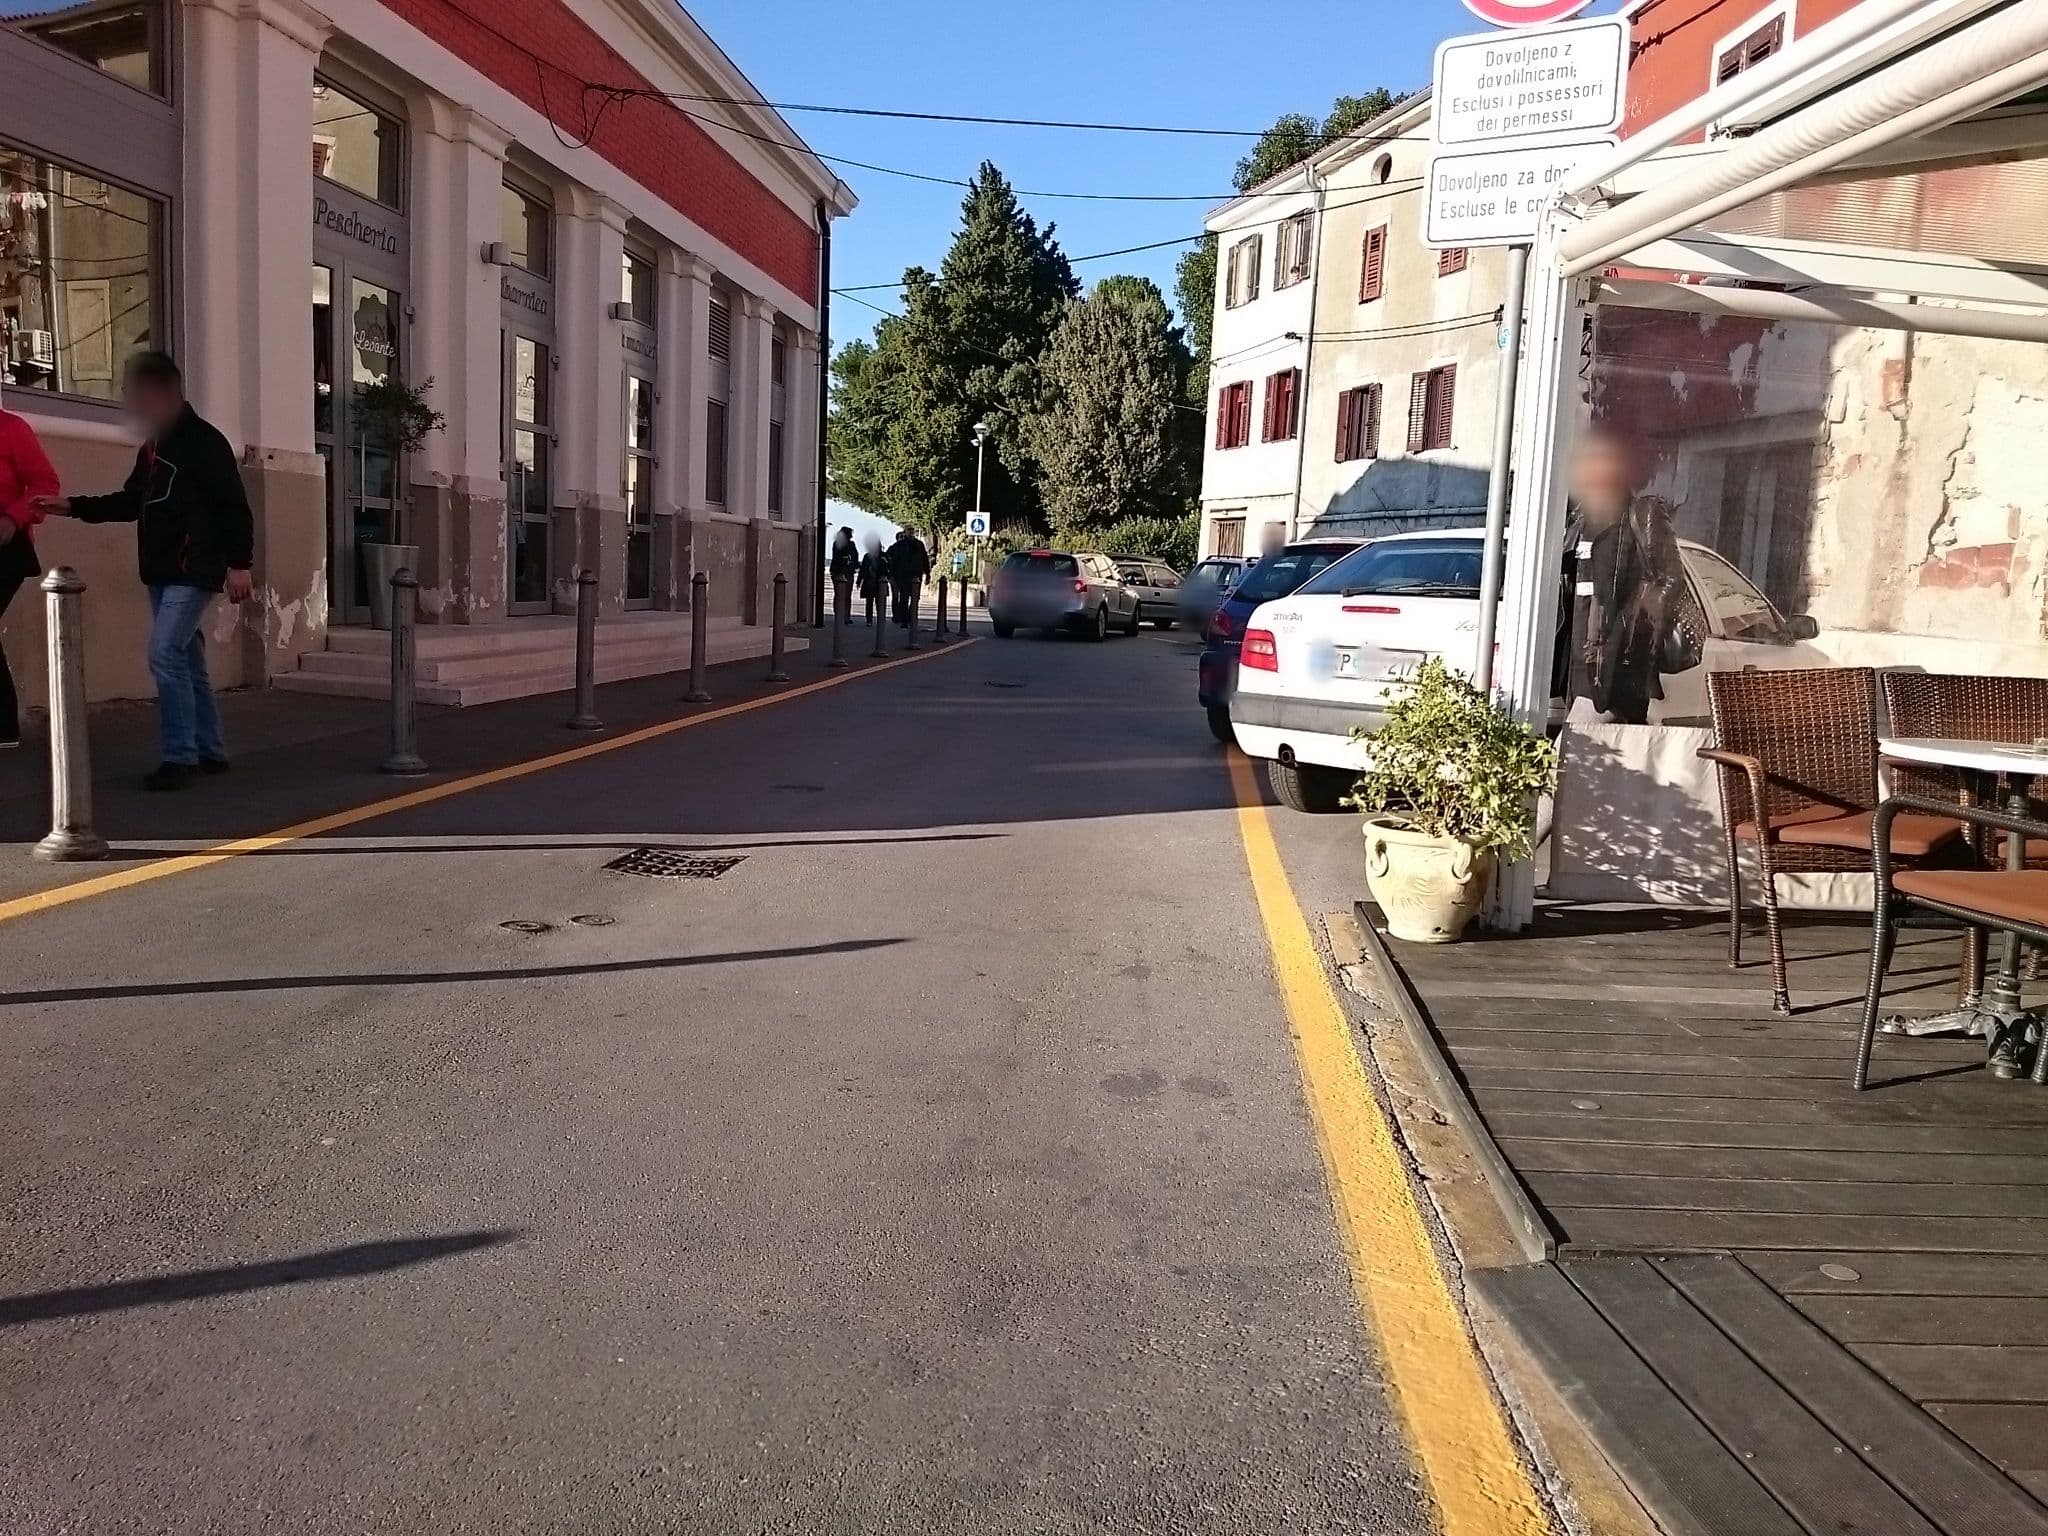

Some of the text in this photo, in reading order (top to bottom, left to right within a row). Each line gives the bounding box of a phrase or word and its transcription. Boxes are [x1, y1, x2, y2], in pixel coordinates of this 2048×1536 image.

[1485, 44, 1572, 67] Dovoljeno z
[1453, 93, 1504, 114] Esclusi
[1518, 80, 1603, 109] possessori
[1477, 106, 1573, 132] dei permessi
[1439, 170, 1508, 194] Dovoljeno
[1517, 171, 1534, 186] za
[1440, 199, 1495, 220] Escluse
[1504, 196, 1517, 214] le
[313, 197, 397, 255] Pescheria
